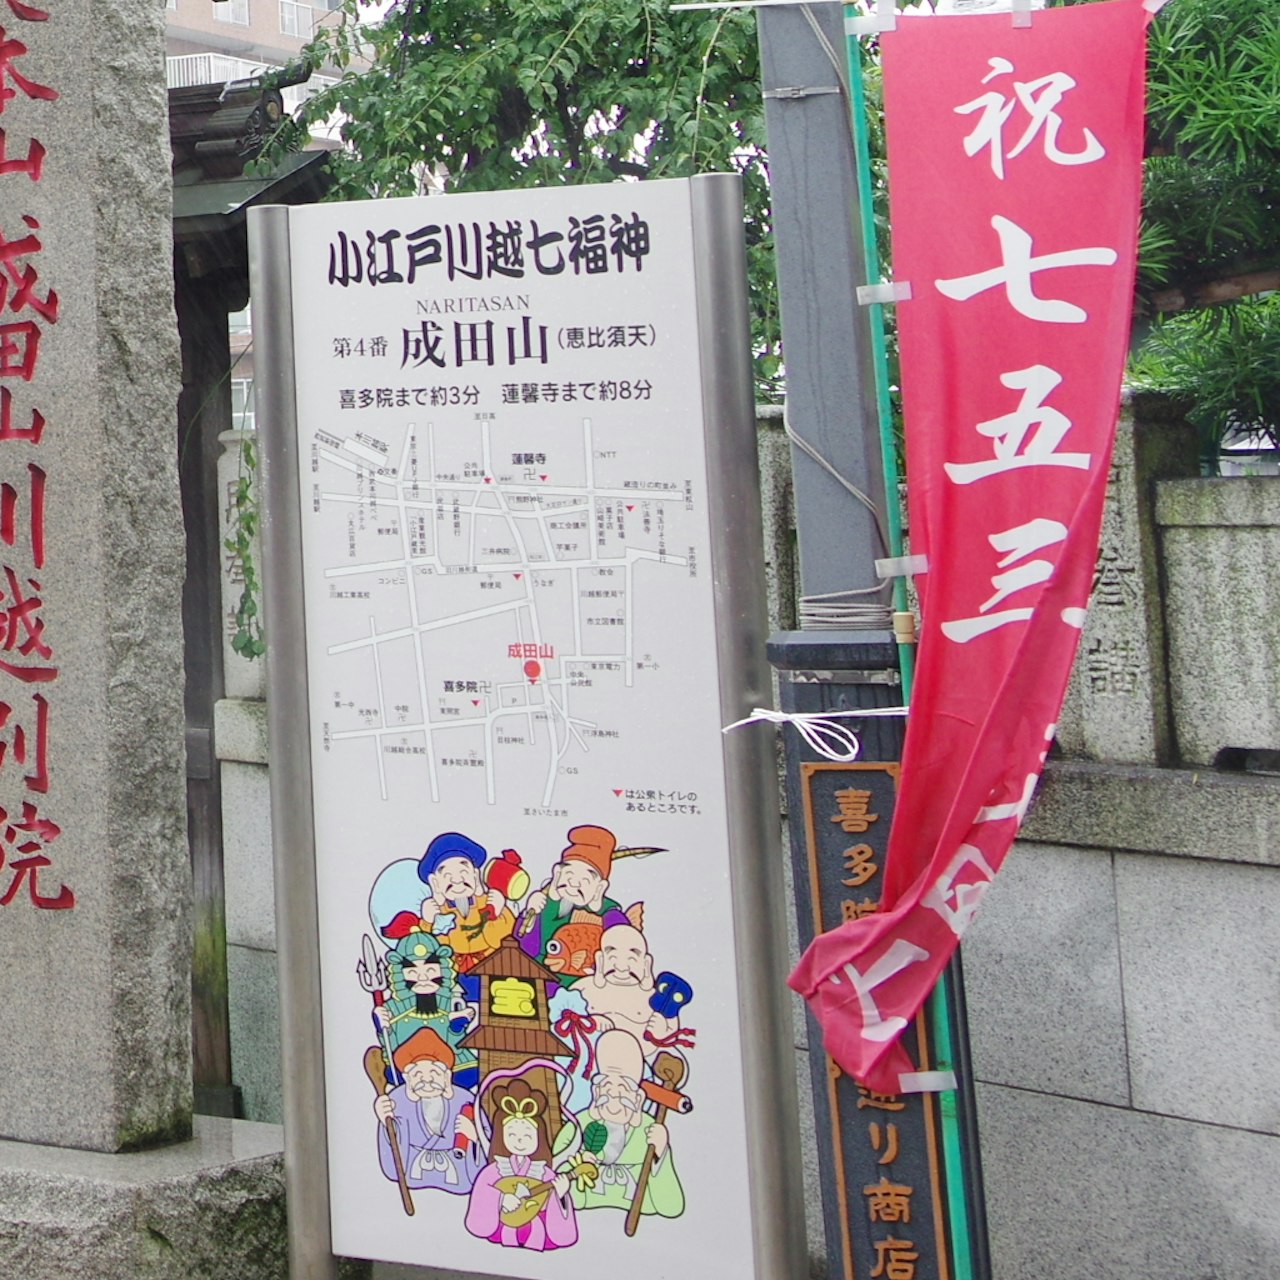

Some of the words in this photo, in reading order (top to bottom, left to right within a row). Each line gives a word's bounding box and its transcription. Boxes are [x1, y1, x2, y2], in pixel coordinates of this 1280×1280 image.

[328, 211, 651, 288] 小江戸川越七福神
[416, 294, 531, 315] NARITASAN
[332, 336, 389, 358] 第4番
[400, 316, 549, 370] 成田山
[935, 58, 1117, 643] 祝七五三
[339, 387, 480, 410] 喜多院まで約3分
[502, 379, 653, 404] 蓮馨寺まで約8分
[600, 451, 617, 459] NTT
[508, 643, 554, 659] 成田山
[443, 681, 478, 693] 喜多院
[625, 789, 697, 802] は公衆トイレの
[626, 802, 701, 815] あるところです。
